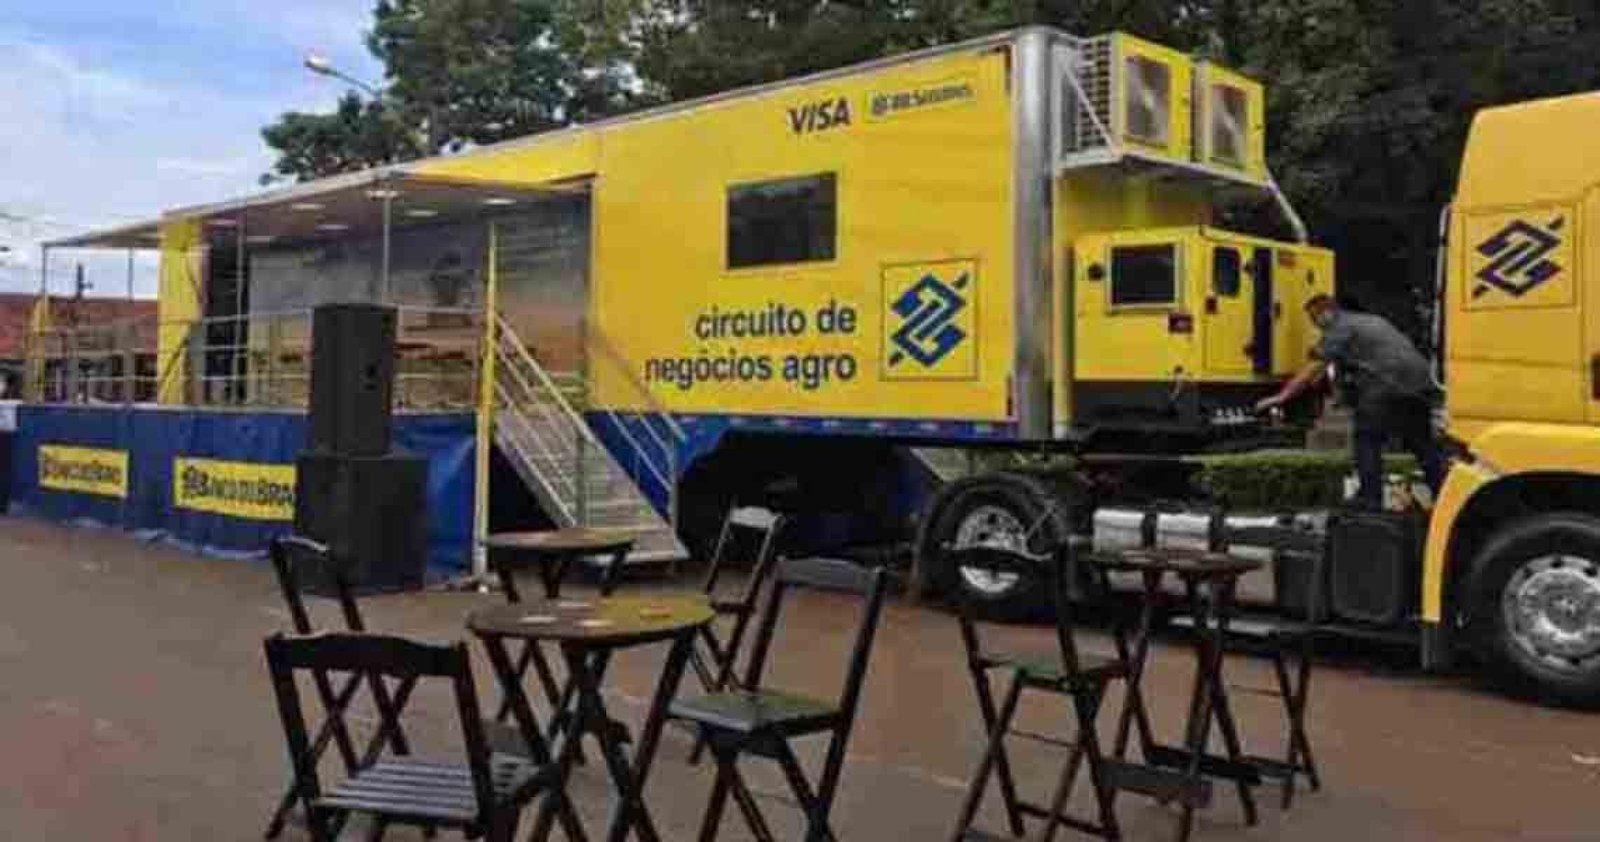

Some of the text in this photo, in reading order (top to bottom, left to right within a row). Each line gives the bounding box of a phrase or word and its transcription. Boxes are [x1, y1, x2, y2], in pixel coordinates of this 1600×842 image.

[787, 97, 851, 135] VISA
[695, 297, 857, 339] circuito de
[643, 348, 857, 390] negócios agro
